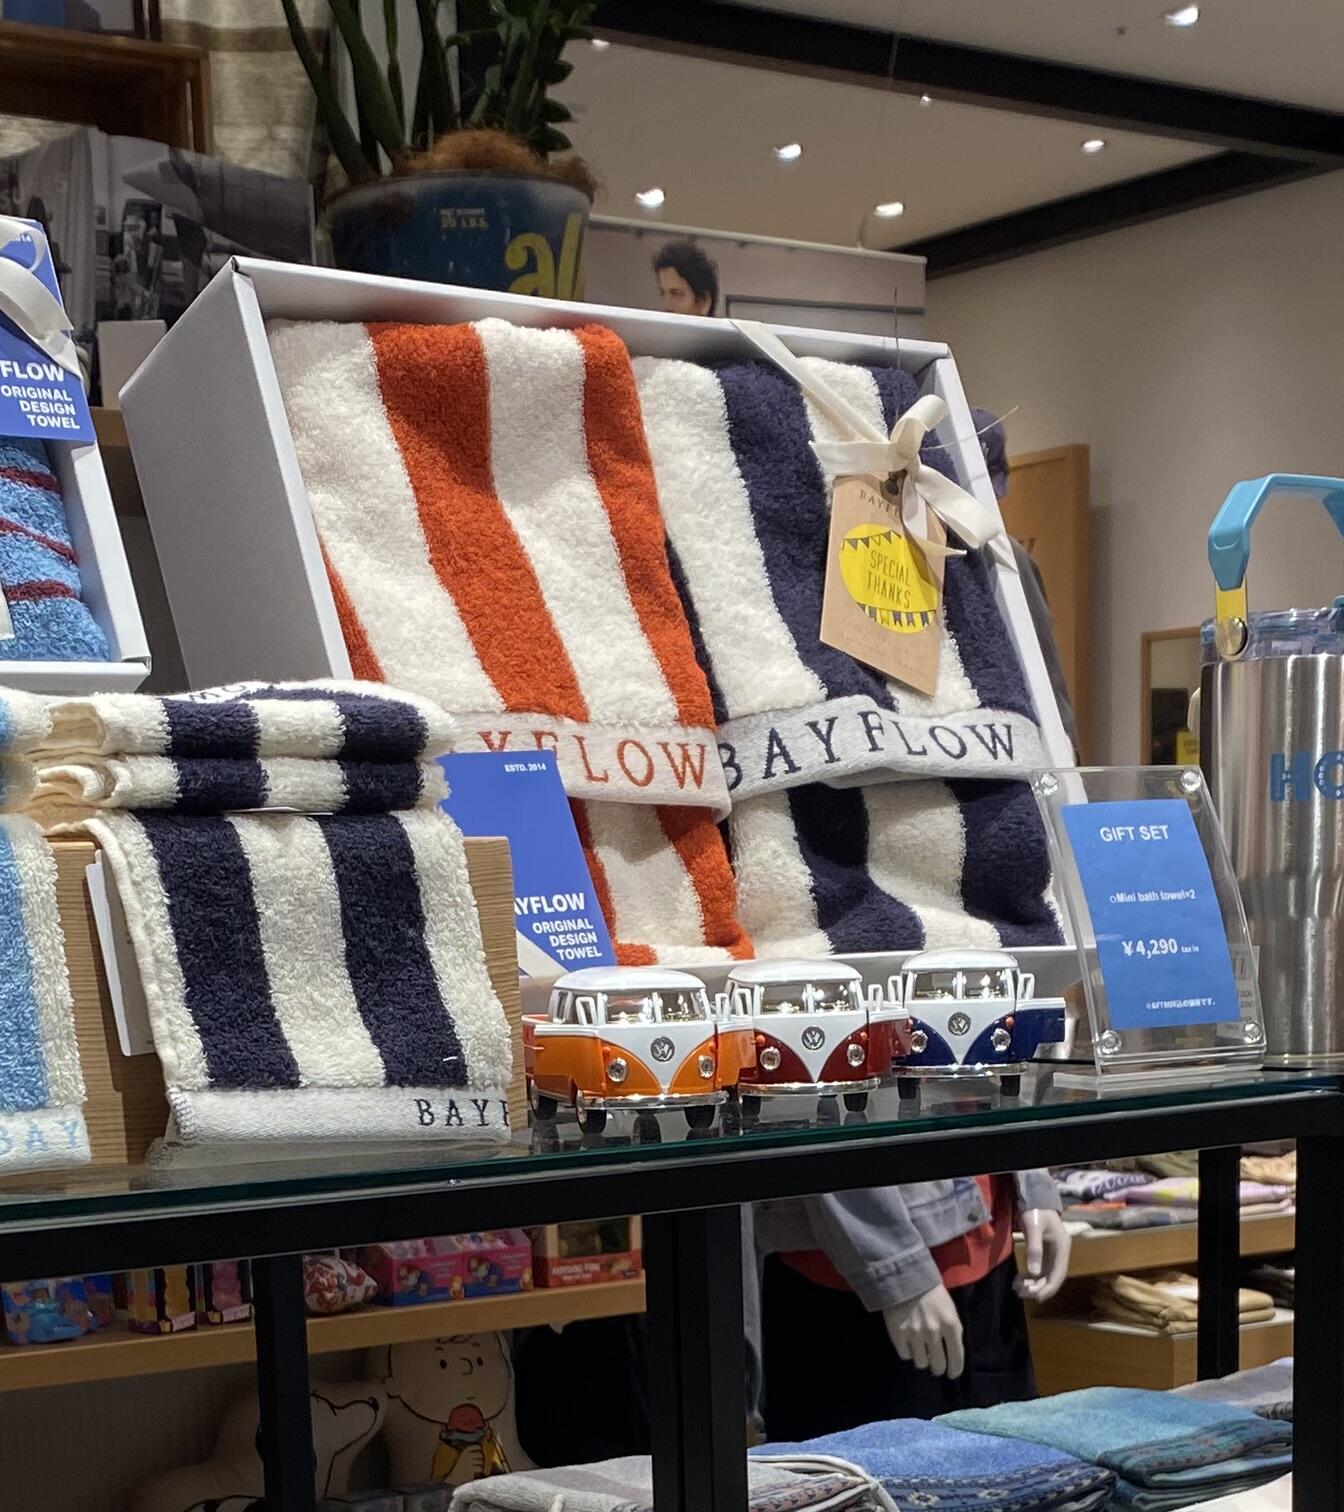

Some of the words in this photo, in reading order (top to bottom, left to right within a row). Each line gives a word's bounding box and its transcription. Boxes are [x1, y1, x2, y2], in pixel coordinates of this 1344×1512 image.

[0, 385, 73, 402] ORIGINAL
[19, 401, 76, 416] DESIGN
[26, 414, 81, 430] TOWEL
[870, 551, 911, 586] SPECIAL
[865, 571, 911, 609] THANKS
[721, 710, 1016, 791] BAYFLOW
[504, 763, 528, 773] ESTD.
[528, 762, 547, 772] 2014
[1099, 826, 1134, 842] GIFT
[1139, 825, 1169, 841] SET
[1138, 890, 1158, 902] bath
[532, 918, 594, 936] ORIGINAL
[548, 931, 598, 948] DESIGN
[555, 943, 603, 961] TOWEL
[1122, 938, 1178, 960] ¥4,290
